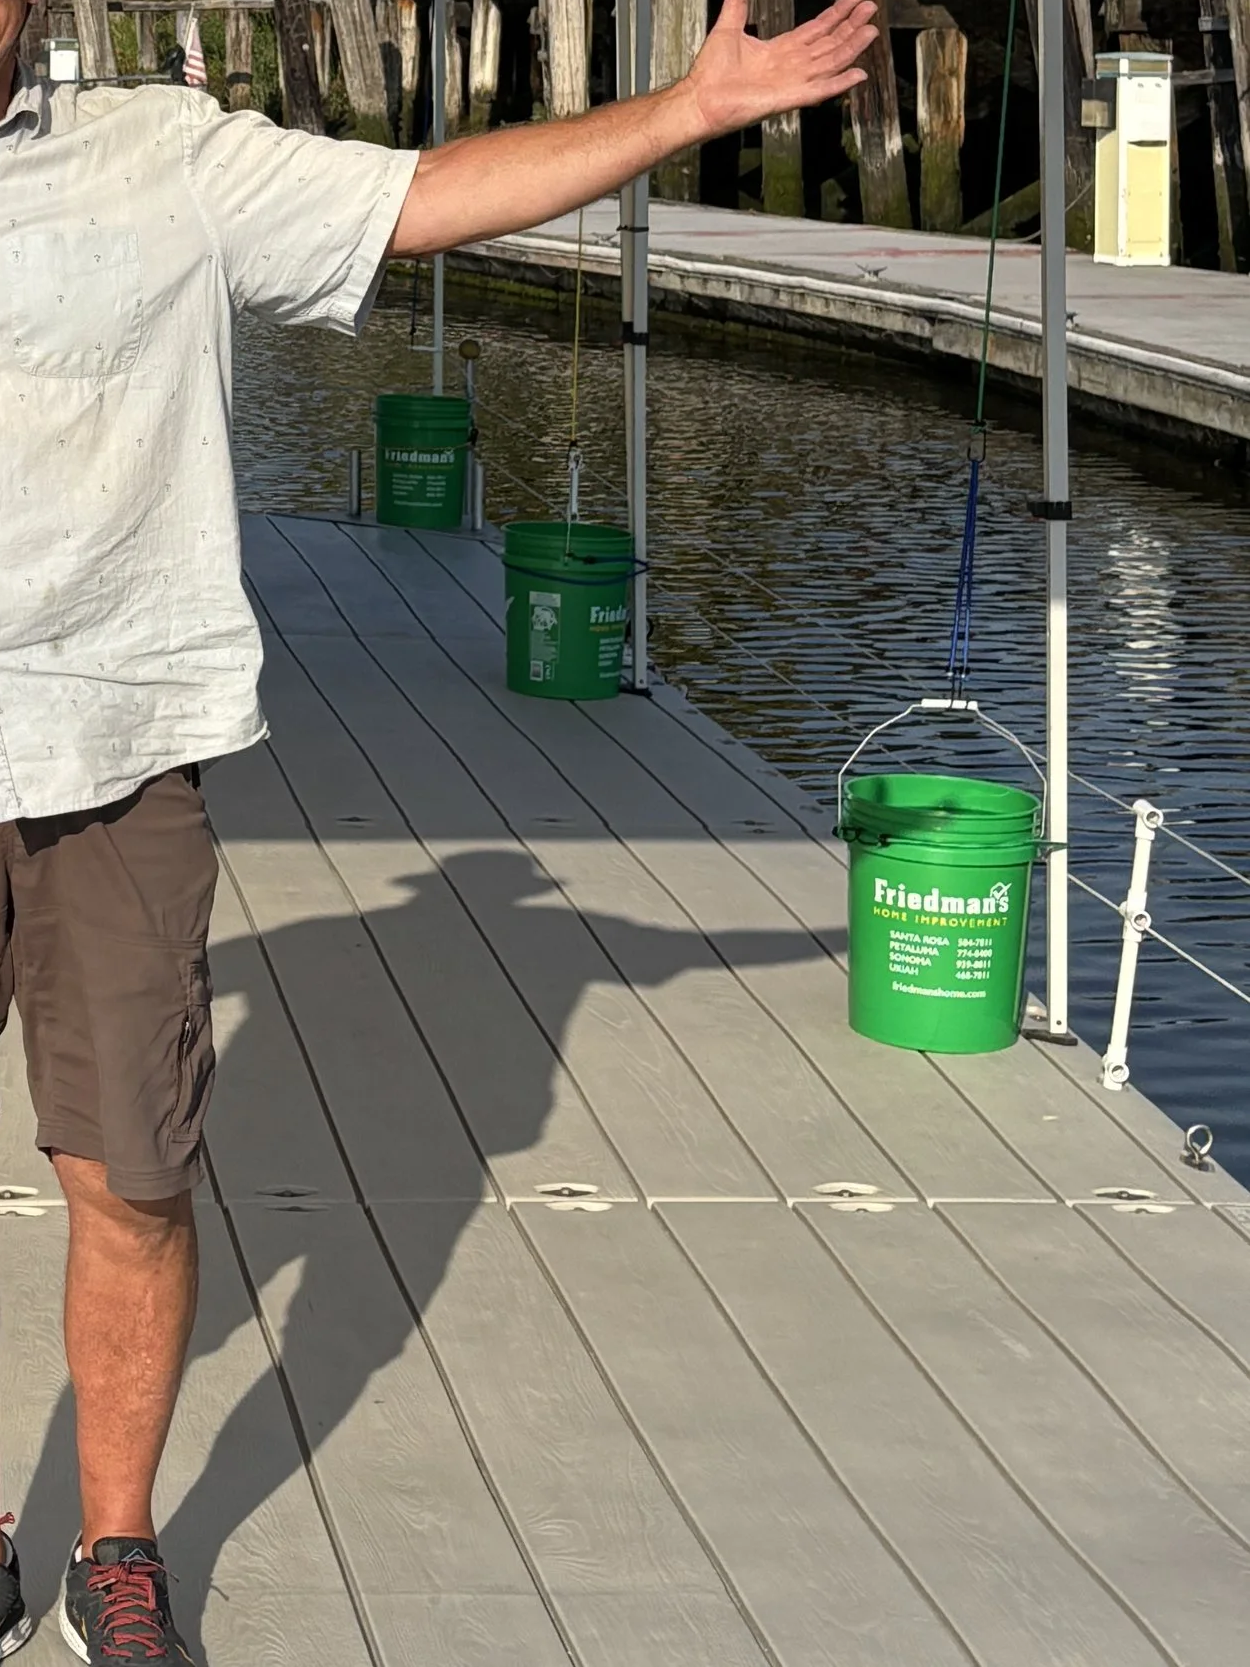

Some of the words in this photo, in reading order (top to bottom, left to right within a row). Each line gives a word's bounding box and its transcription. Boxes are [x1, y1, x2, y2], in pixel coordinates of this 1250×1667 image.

[873, 905, 908, 922] HOME
[914, 914, 1008, 929] IMPROVEMENT
[889, 940, 940, 957] PETALUMA
[889, 951, 932, 967] SONOMA
